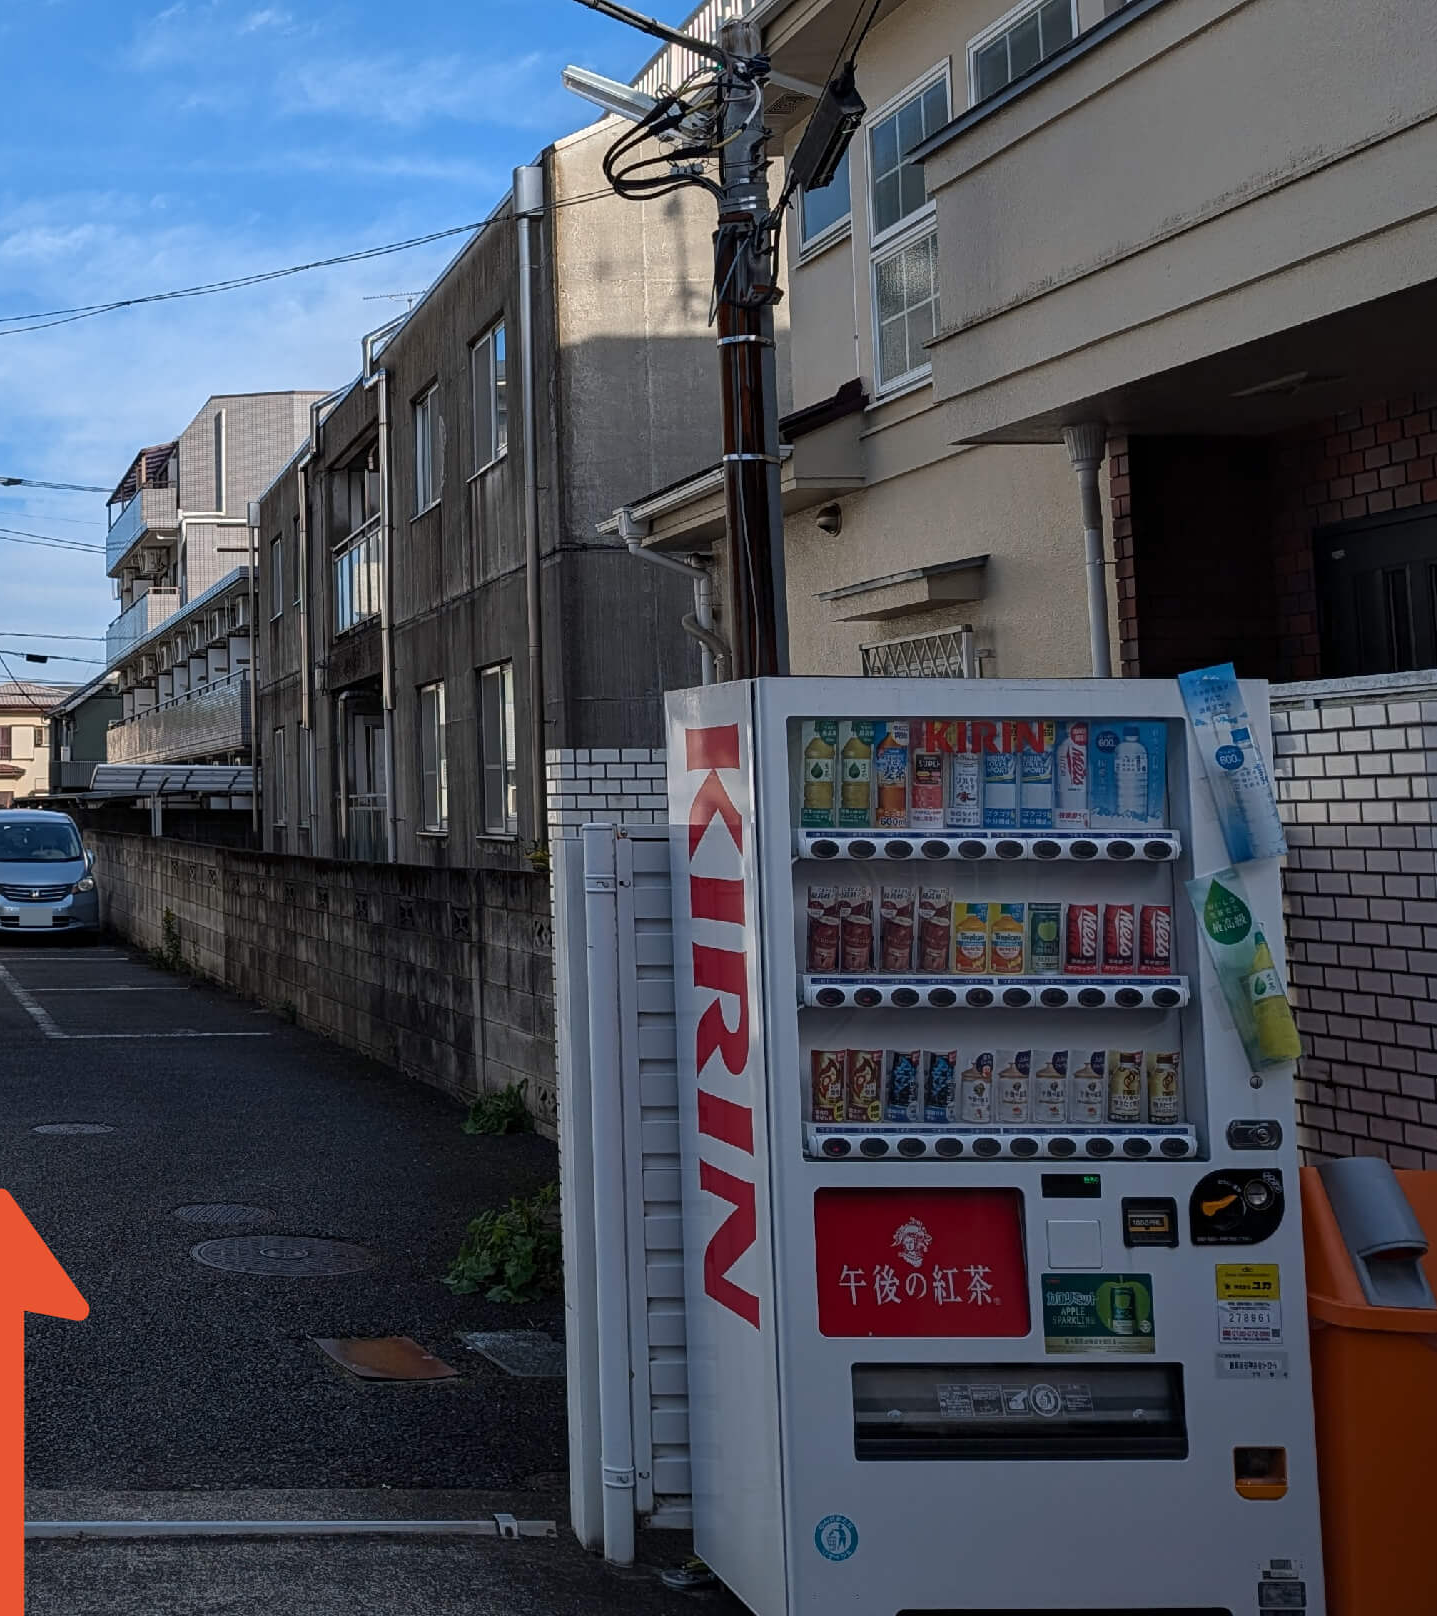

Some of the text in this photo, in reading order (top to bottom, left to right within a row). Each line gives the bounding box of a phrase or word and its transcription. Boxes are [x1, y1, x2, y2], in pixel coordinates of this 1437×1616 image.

[925, 719, 1045, 753] KIRIN
[1082, 908, 1098, 956] Mets
[1118, 908, 1135, 957] Mets
[1155, 910, 1171, 957] Mets
[685, 726, 760, 1332] KIRIN
[839, 1264, 994, 1306] 午後の紅茶
[1060, 1307, 1086, 1316] APPLE
